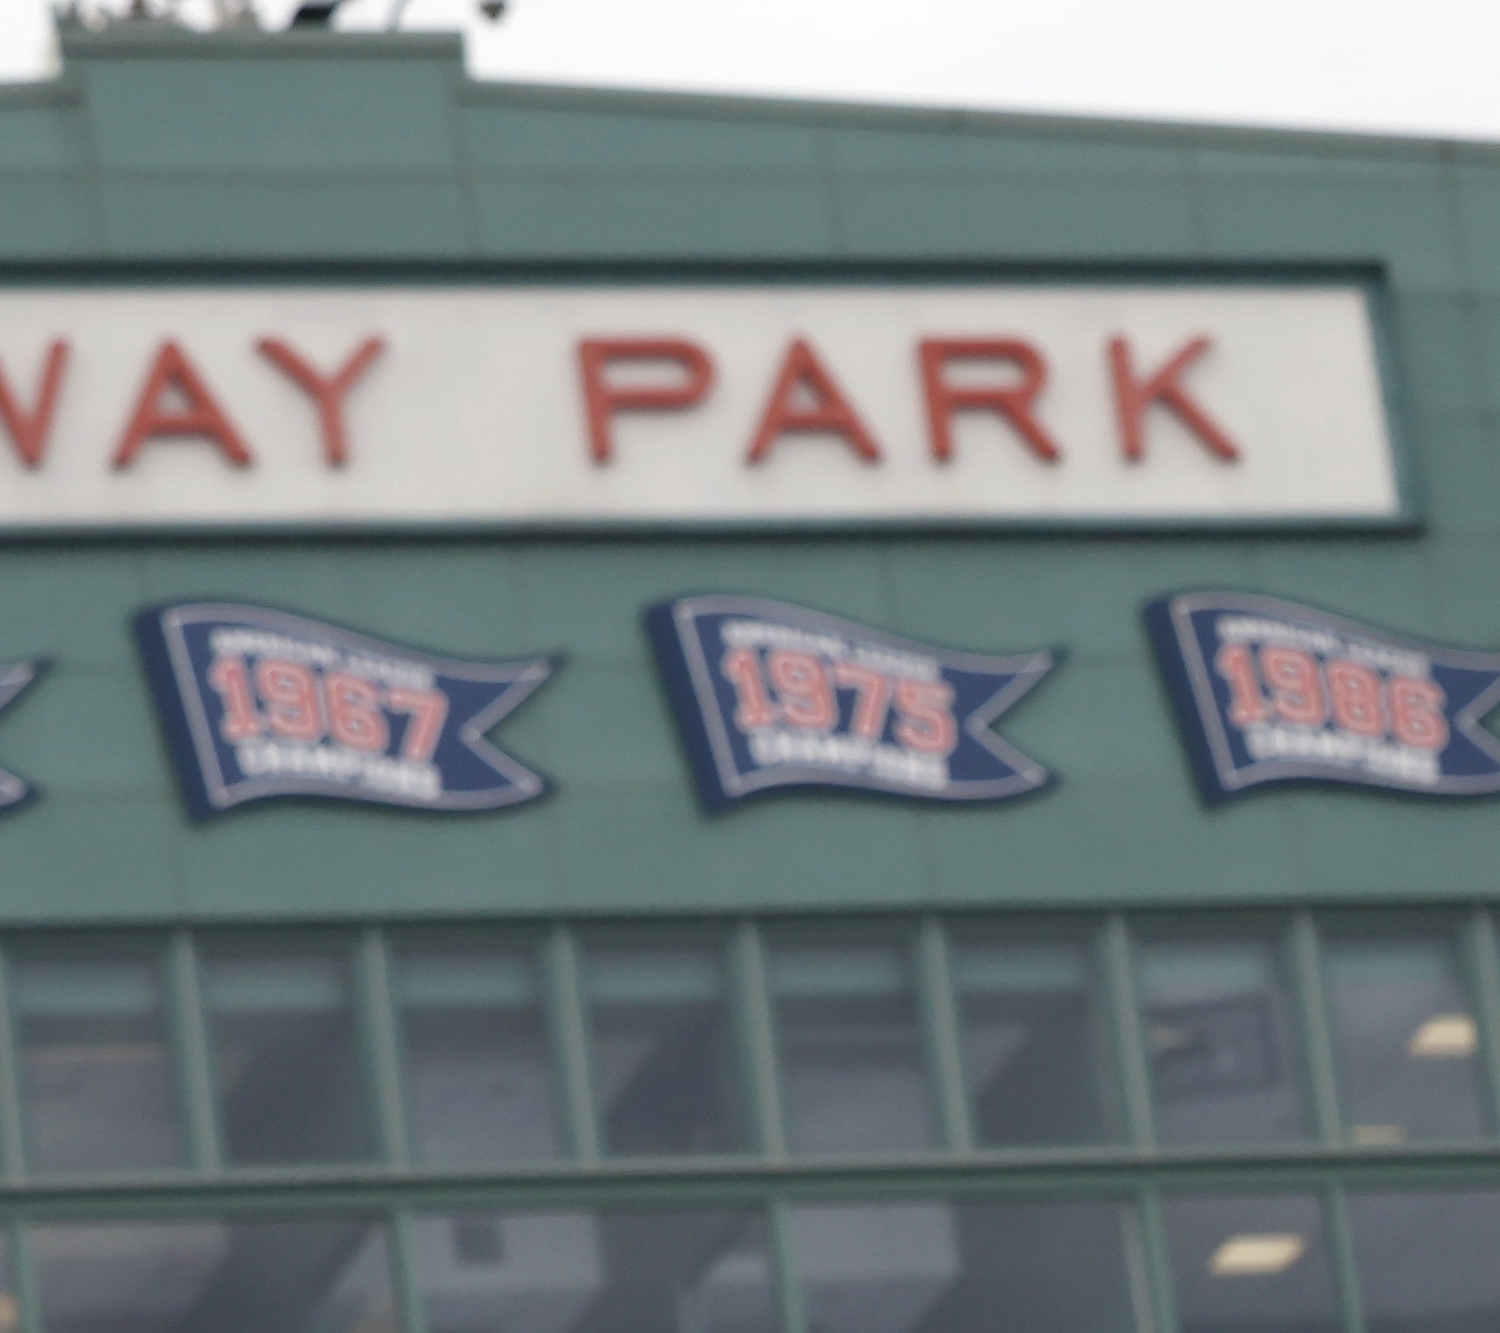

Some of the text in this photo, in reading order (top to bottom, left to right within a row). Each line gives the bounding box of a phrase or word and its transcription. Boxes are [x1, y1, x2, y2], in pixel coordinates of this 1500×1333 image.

[574, 333, 1240, 470] PARK
[208, 655, 449, 761] 1967
[722, 647, 957, 753] 1975
[1216, 643, 1449, 750] 1986
